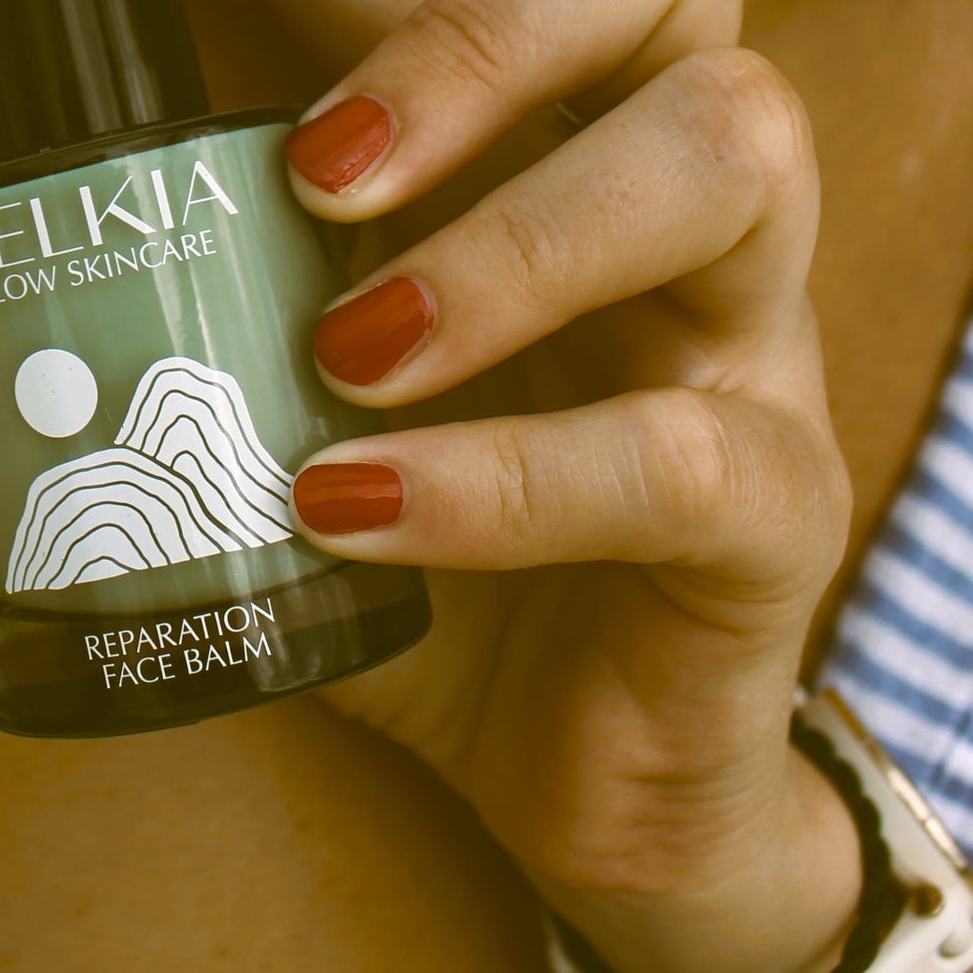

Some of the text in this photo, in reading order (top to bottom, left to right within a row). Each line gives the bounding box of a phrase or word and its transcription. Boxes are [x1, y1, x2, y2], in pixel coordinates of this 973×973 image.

[67, 229, 217, 286] SKINCARE
[84, 598, 276, 660] REPARATION
[102, 632, 272, 689] FACE BALM
